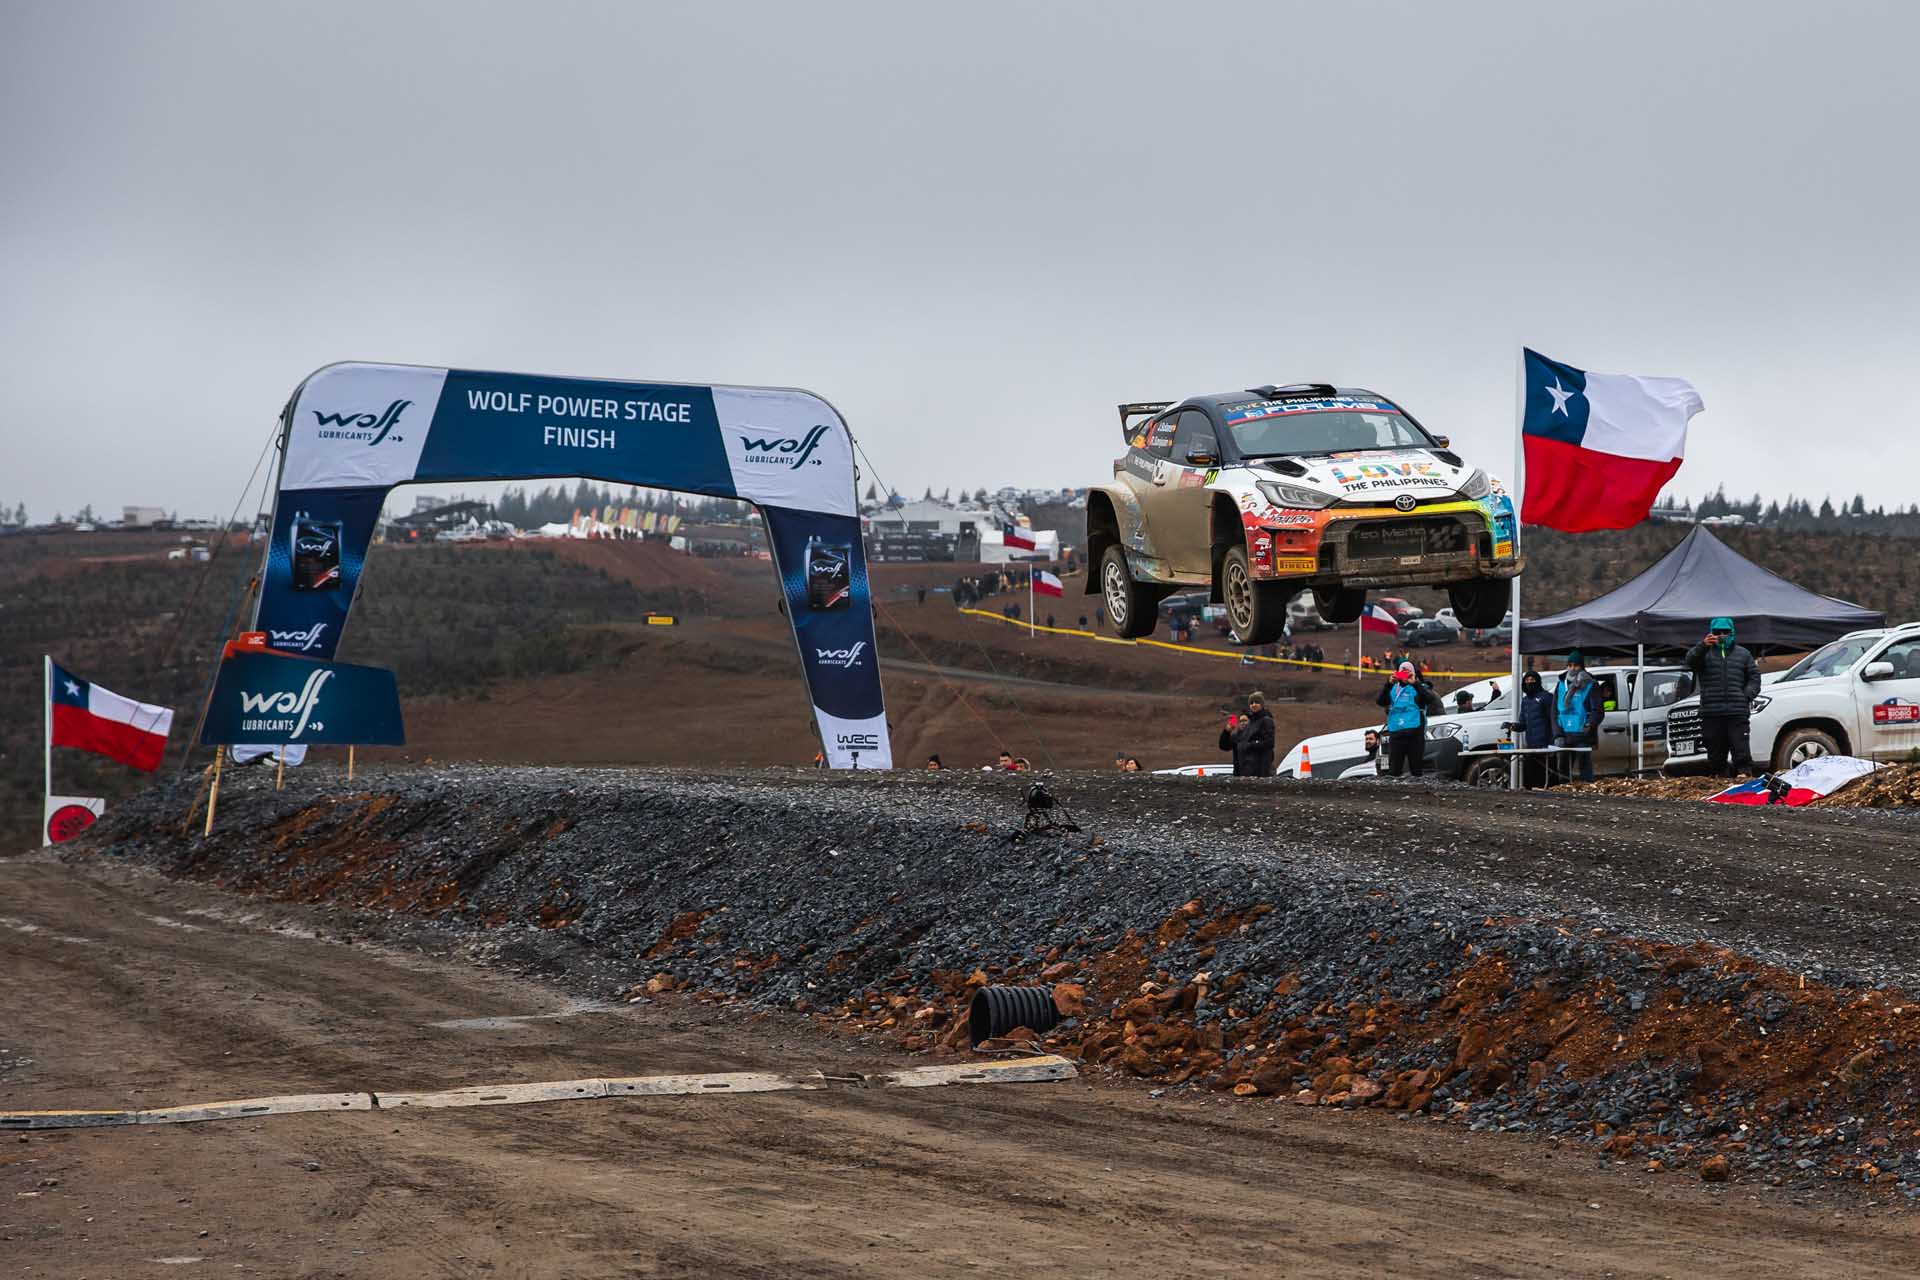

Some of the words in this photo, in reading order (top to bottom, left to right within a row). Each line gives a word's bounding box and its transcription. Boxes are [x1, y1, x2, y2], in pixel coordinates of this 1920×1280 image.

[467, 390, 532, 412] WOLF
[538, 395, 618, 419] POWER
[624, 401, 691, 423] STAGE
[1262, 399, 1283, 407] THE
[1286, 396, 1354, 404] PHILIPPINES
[318, 430, 373, 441] LUBRICANTS
[543, 426, 615, 449] FINISH
[745, 455, 794, 465] LUBRICANTS
[1331, 462, 1441, 484] LOVE
[1343, 481, 1368, 492] THE
[1372, 478, 1449, 488] PHILIPPINES
[1279, 559, 1314, 569] PIRELLI
[242, 719, 294, 731] LUBRICANTS
